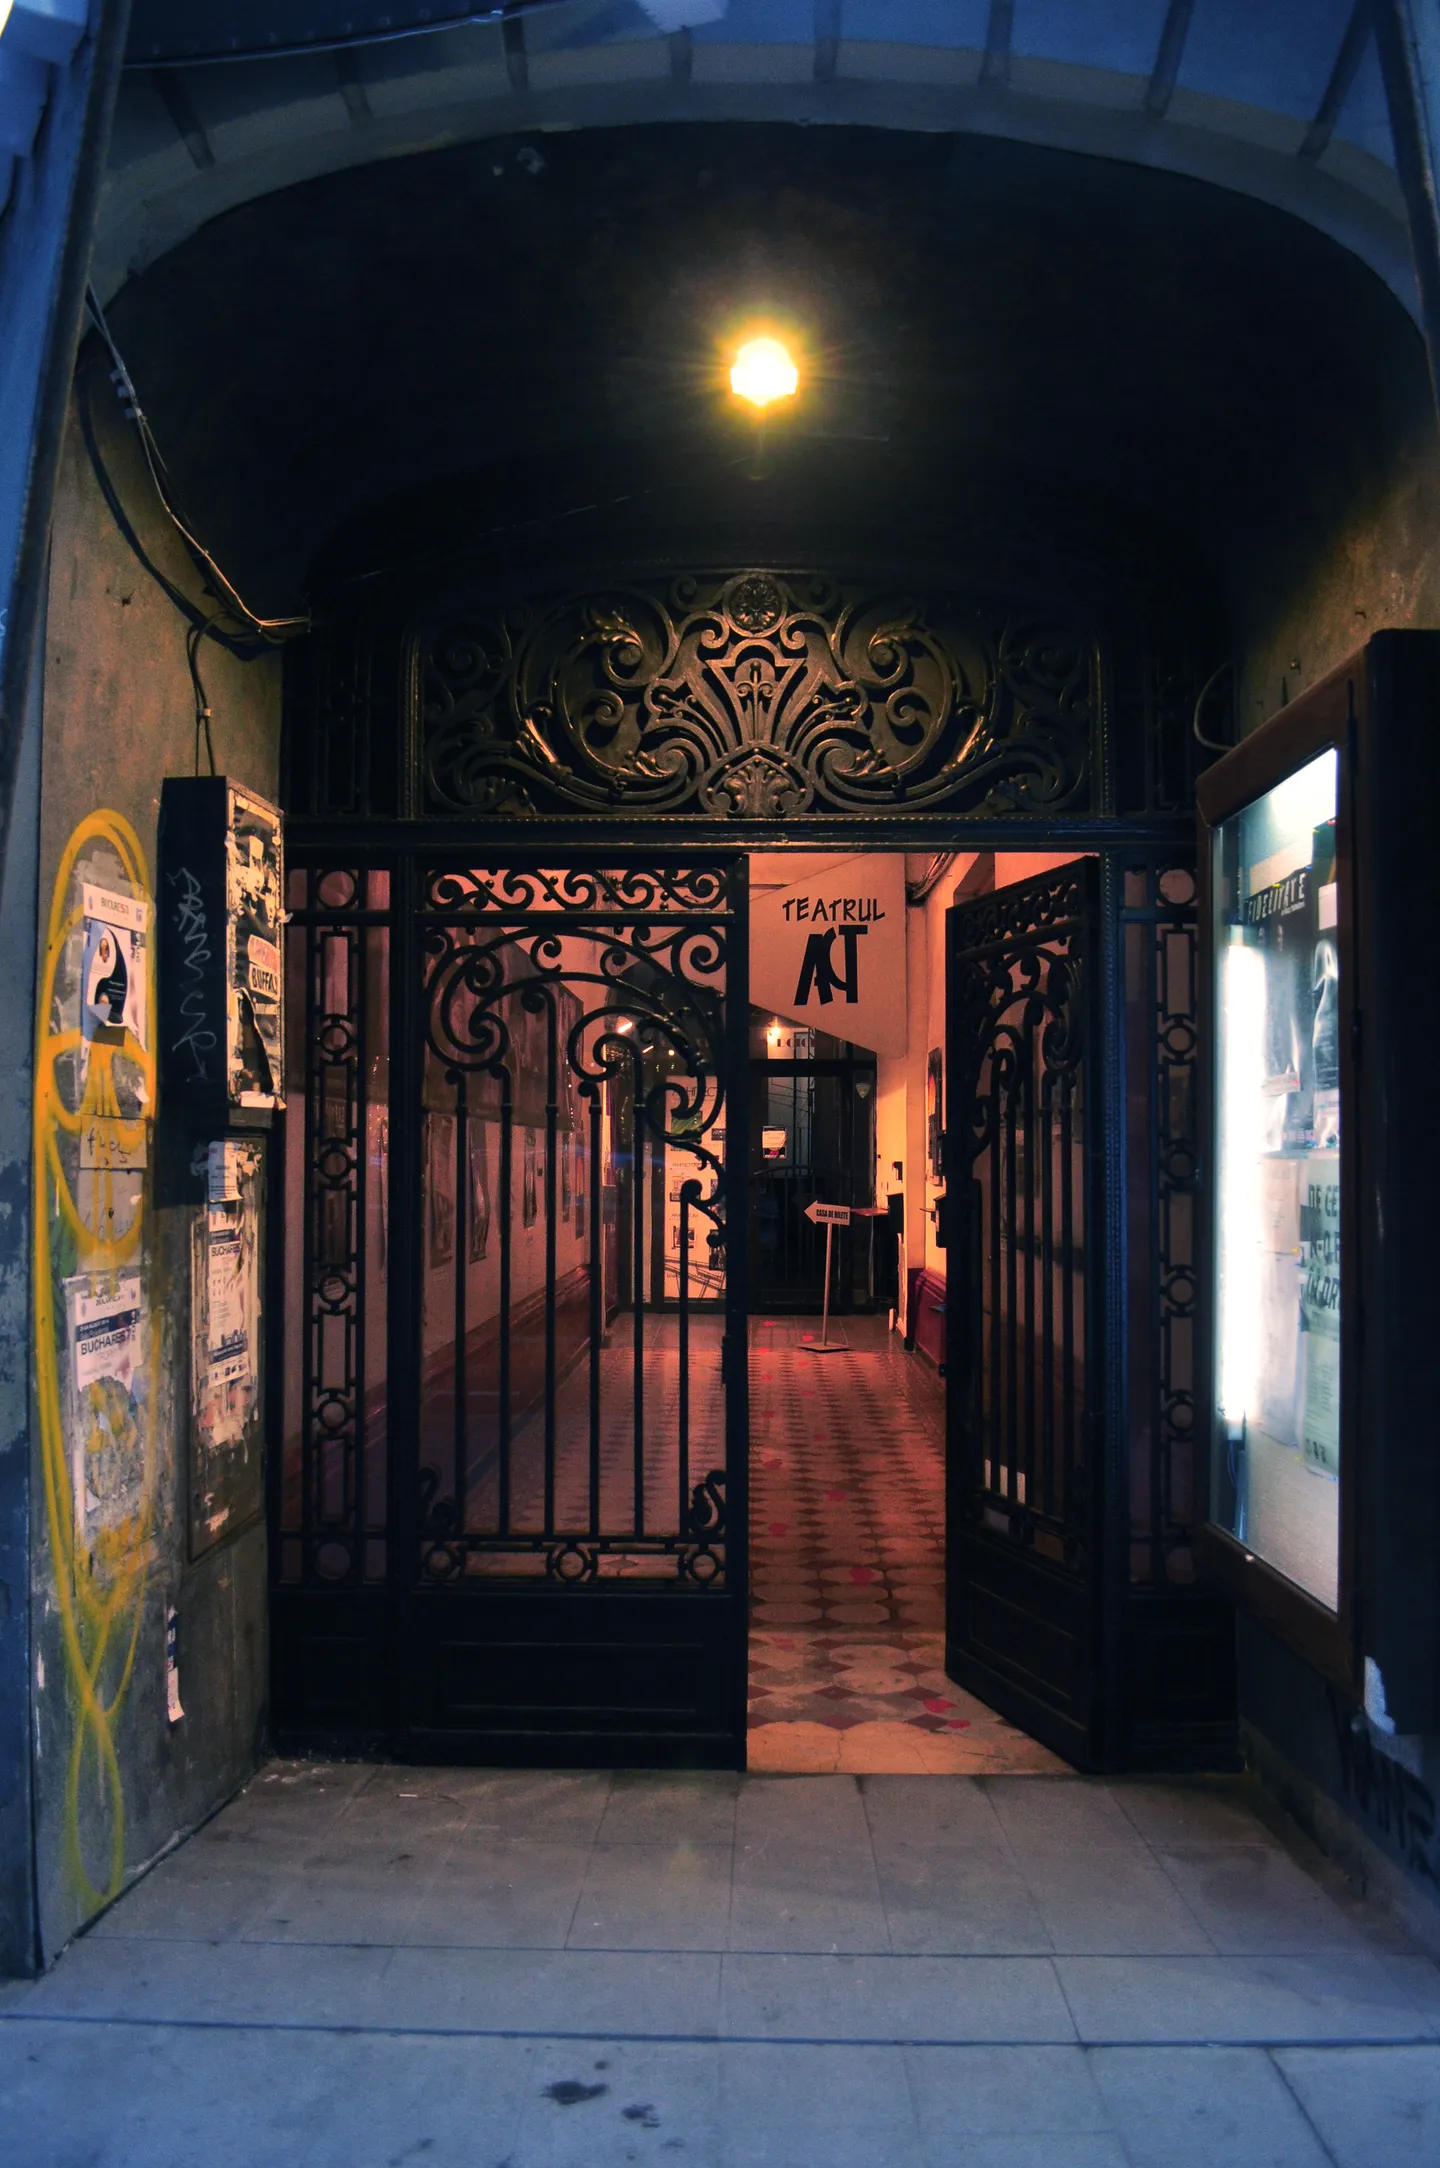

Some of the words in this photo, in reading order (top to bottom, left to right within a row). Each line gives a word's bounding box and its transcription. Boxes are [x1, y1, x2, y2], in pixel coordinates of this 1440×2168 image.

[782, 897, 885, 922] TEATRUL
[816, 1209, 828, 1217] CASA
[828, 1210, 834, 1218] DE
[834, 1210, 849, 1220] BILETE
